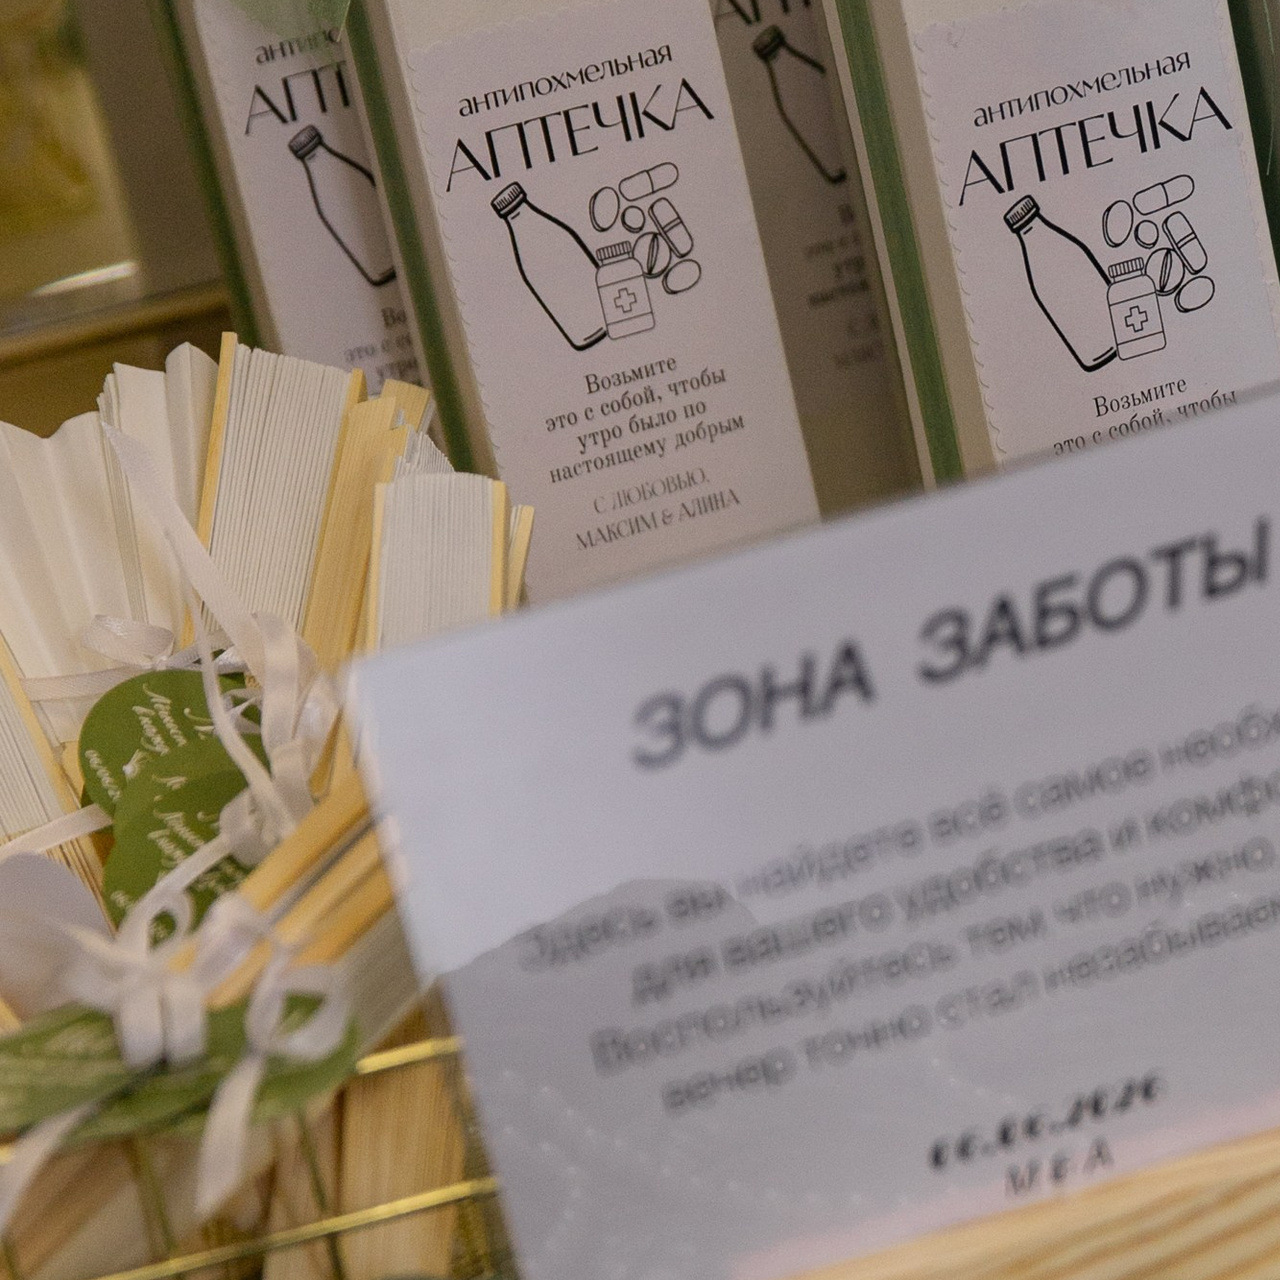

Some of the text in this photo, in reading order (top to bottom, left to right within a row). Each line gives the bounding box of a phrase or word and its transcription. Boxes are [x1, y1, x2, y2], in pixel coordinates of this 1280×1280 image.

[458, 43, 672, 117] антипохмельная
[973, 51, 1191, 127] антипохмельная
[445, 77, 715, 193] АПТЕЧКА
[958, 85, 1233, 206] АПТЕЧКА
[544, 411, 578, 432] это
[599, 384, 662, 416] собой,
[666, 366, 726, 396] чтобы
[583, 357, 677, 395] Возьмите
[1092, 378, 1186, 418] Возьмите
[548, 414, 745, 484] настоящему добрым
[576, 400, 707, 455] утро было по
[632, 513, 1272, 772] ЗОНА ЗАБОТЫ
